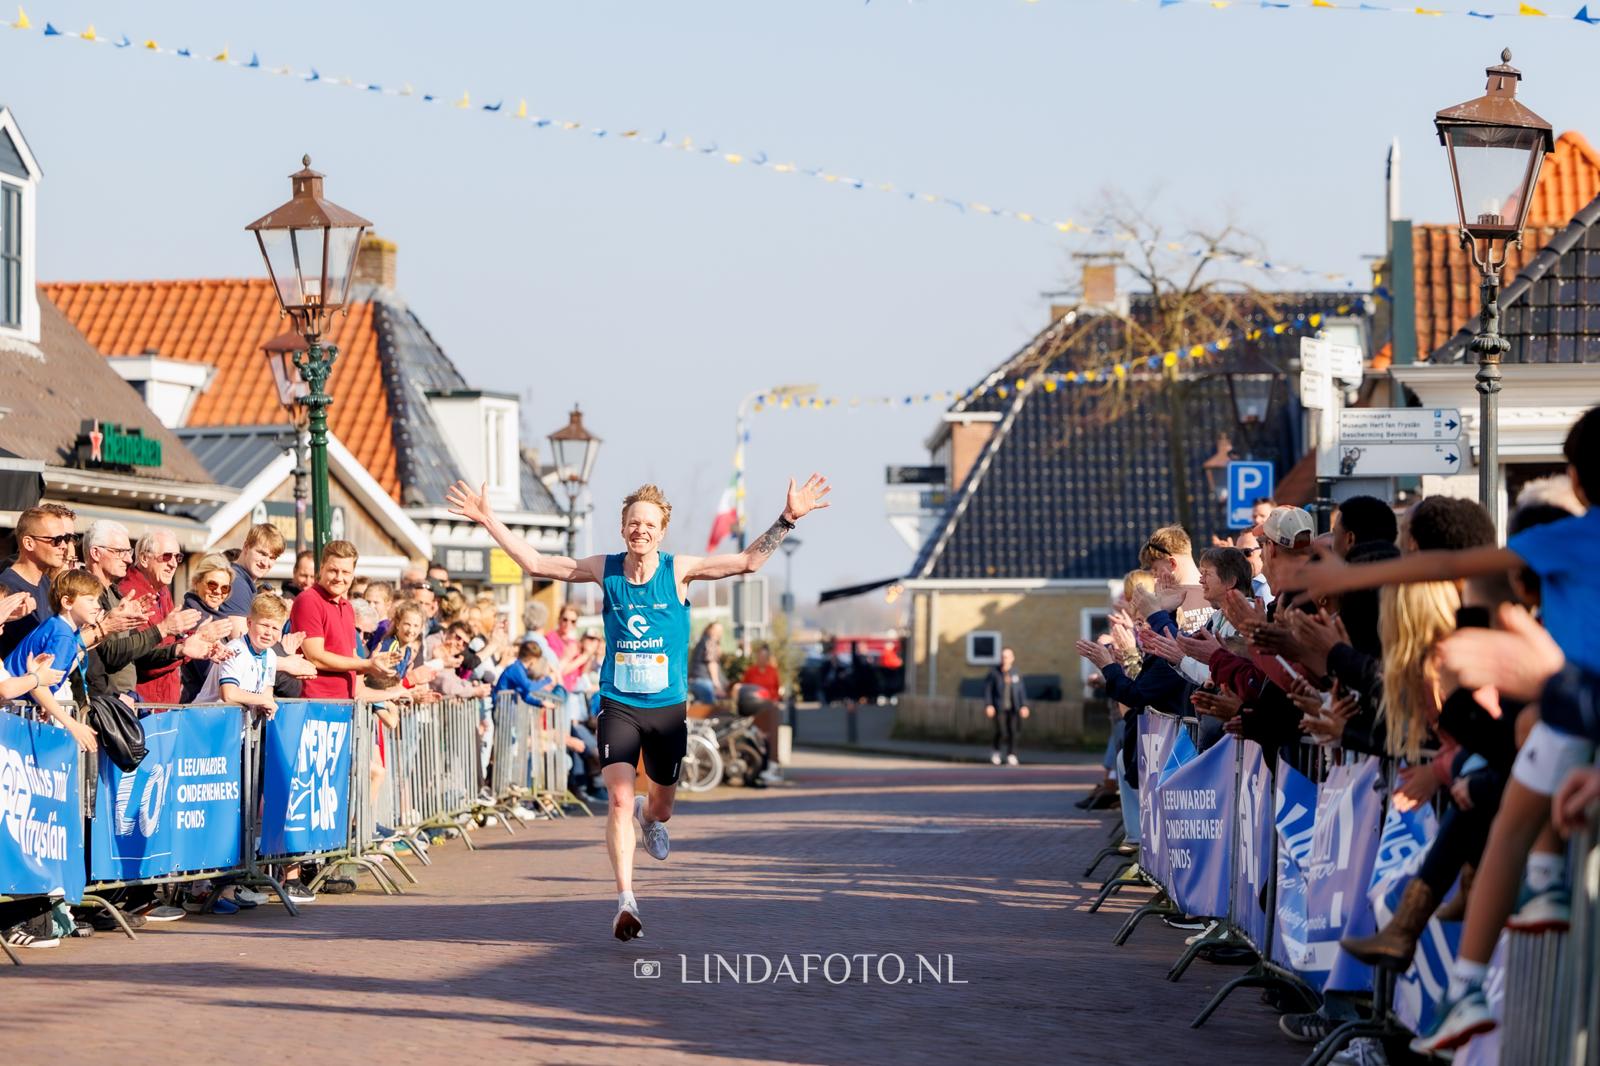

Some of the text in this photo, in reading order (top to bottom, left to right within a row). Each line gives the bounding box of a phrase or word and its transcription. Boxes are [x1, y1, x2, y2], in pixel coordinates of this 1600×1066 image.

[103, 421, 163, 467] Heineken
[1238, 467, 1262, 500] P
[616, 636, 664, 651] runpoint
[178, 756, 228, 777] LEEUWARDER
[177, 781, 239, 803] ONDERNEMERS
[176, 809, 205, 830] FONDS
